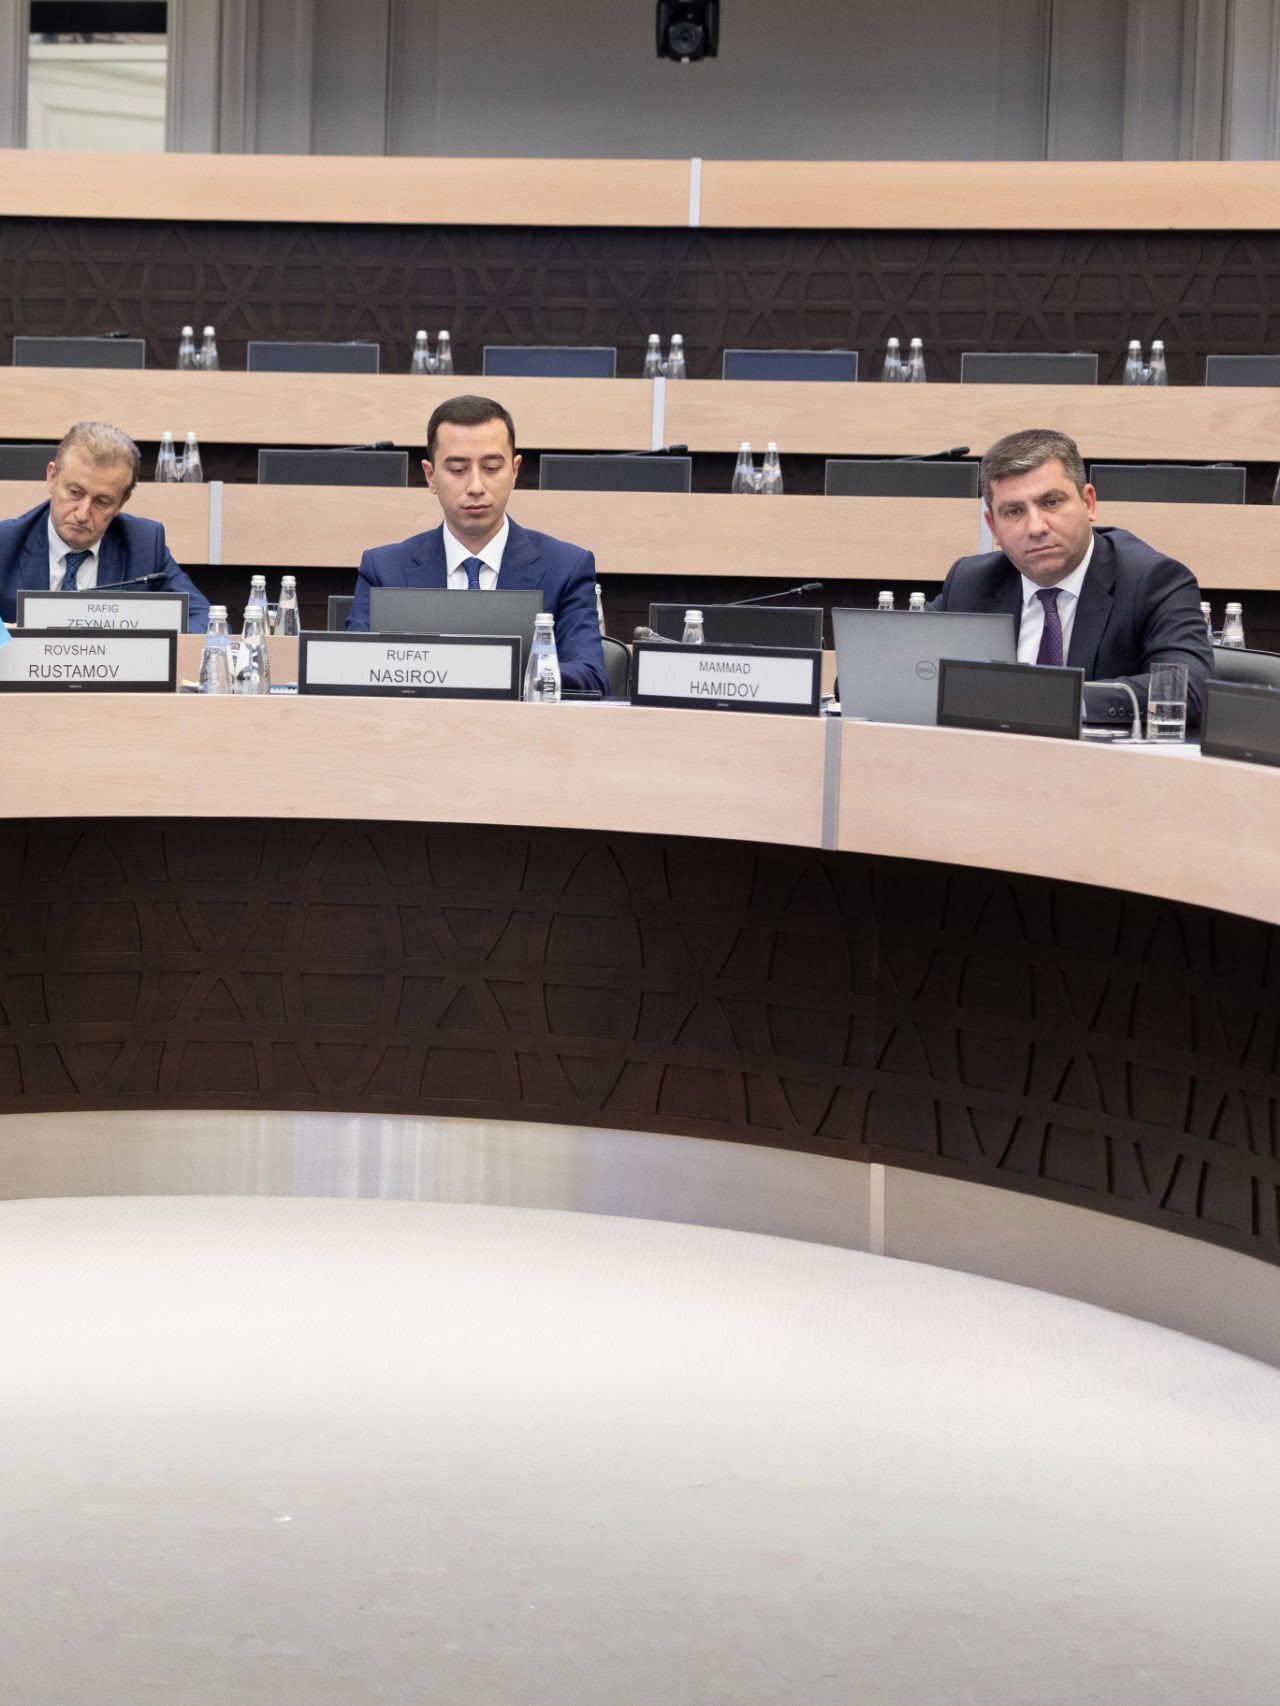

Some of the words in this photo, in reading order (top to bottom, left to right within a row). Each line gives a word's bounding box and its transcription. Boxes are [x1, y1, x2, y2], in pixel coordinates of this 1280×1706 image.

[87, 604, 119, 613] RAFIG
[44, 644, 106, 656] ROVSHAN
[386, 649, 430, 661] RUFAT
[29, 664, 120, 678] RUSTAMOV
[699, 661, 751, 674] MAMMAD
[369, 669, 448, 684] NASIROV
[690, 681, 759, 697] HAMIDOV
